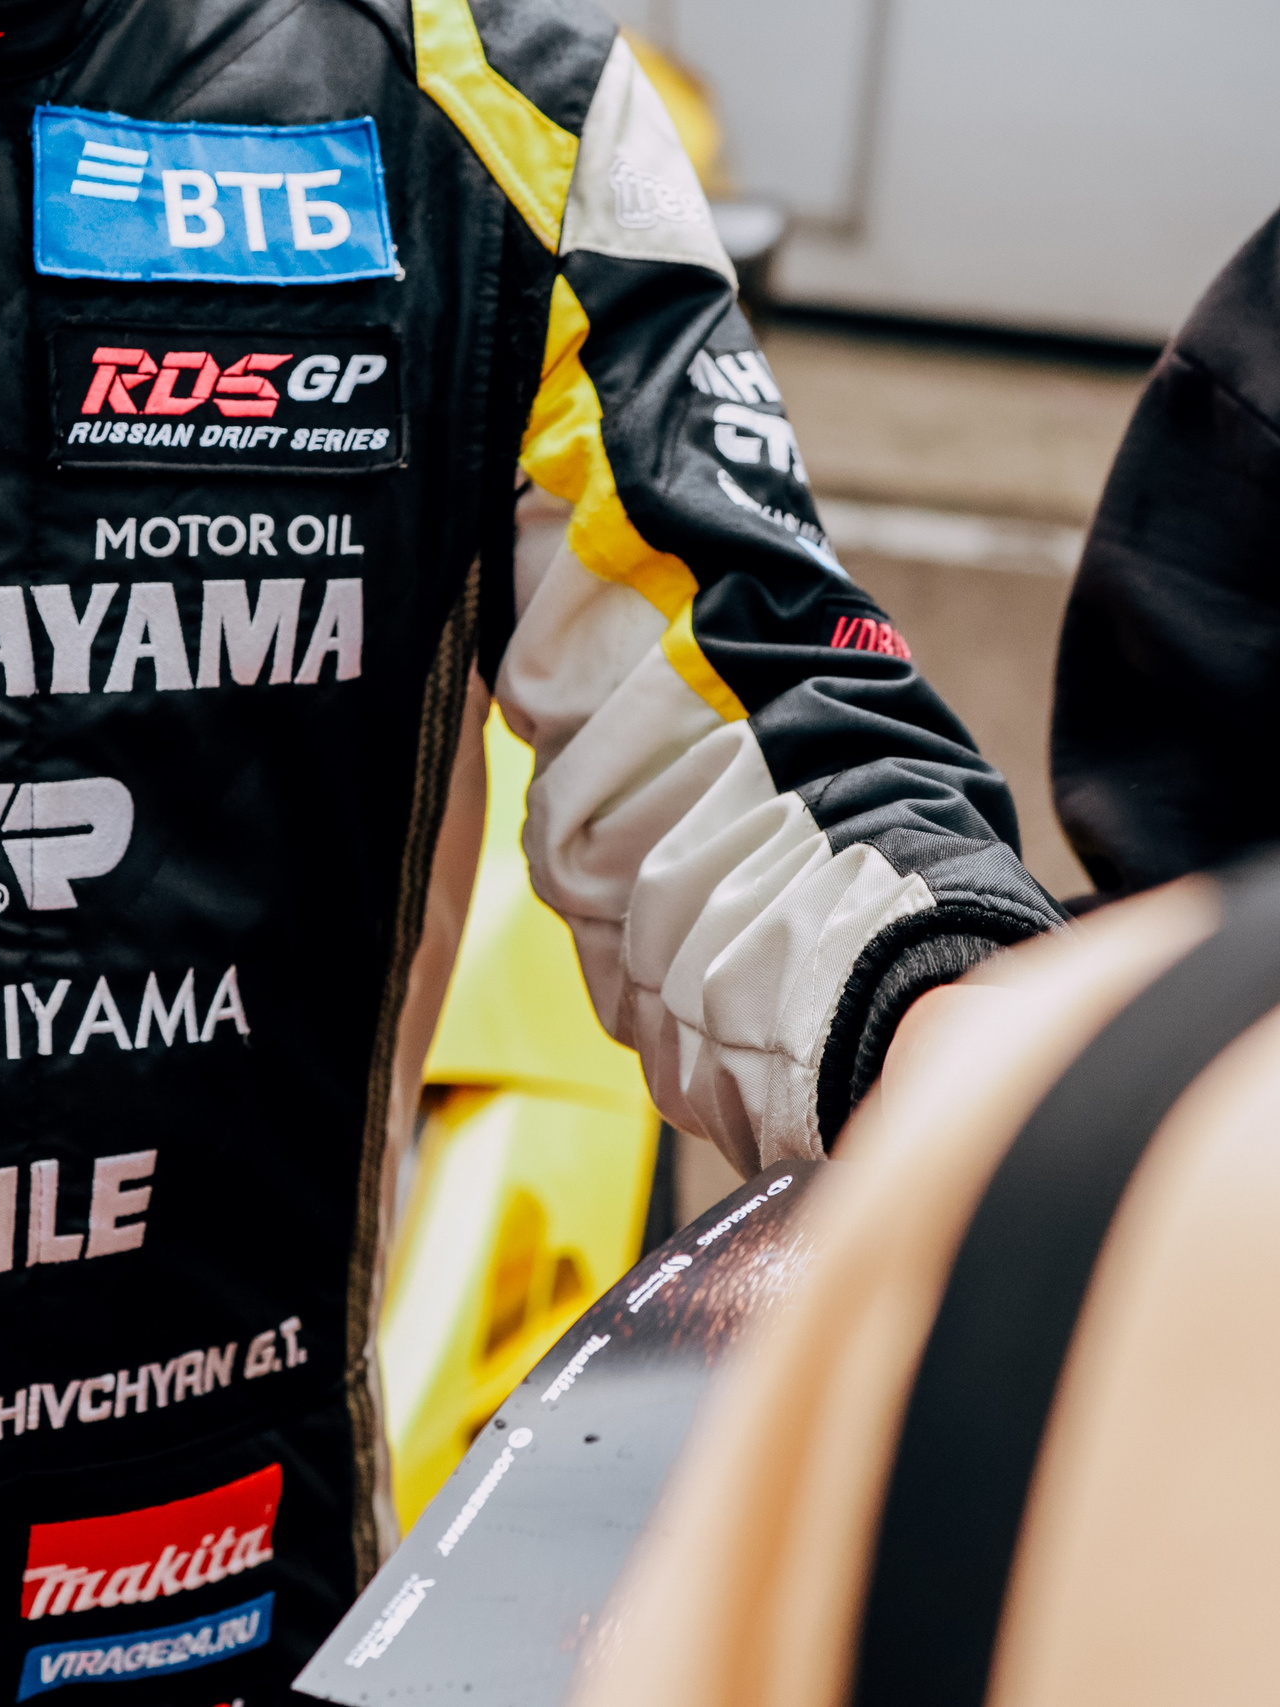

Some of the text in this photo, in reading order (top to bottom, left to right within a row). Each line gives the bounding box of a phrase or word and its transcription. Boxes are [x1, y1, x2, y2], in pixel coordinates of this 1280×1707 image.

[161, 168, 351, 252] ВТБ
[81, 346, 387, 418] RDS GP
[68, 421, 390, 451] RUSSIAN DRIFT SERIES
[95, 513, 364, 560] MOTOR OIL
[41, 1610, 260, 1684] VIRAGE24.RU
